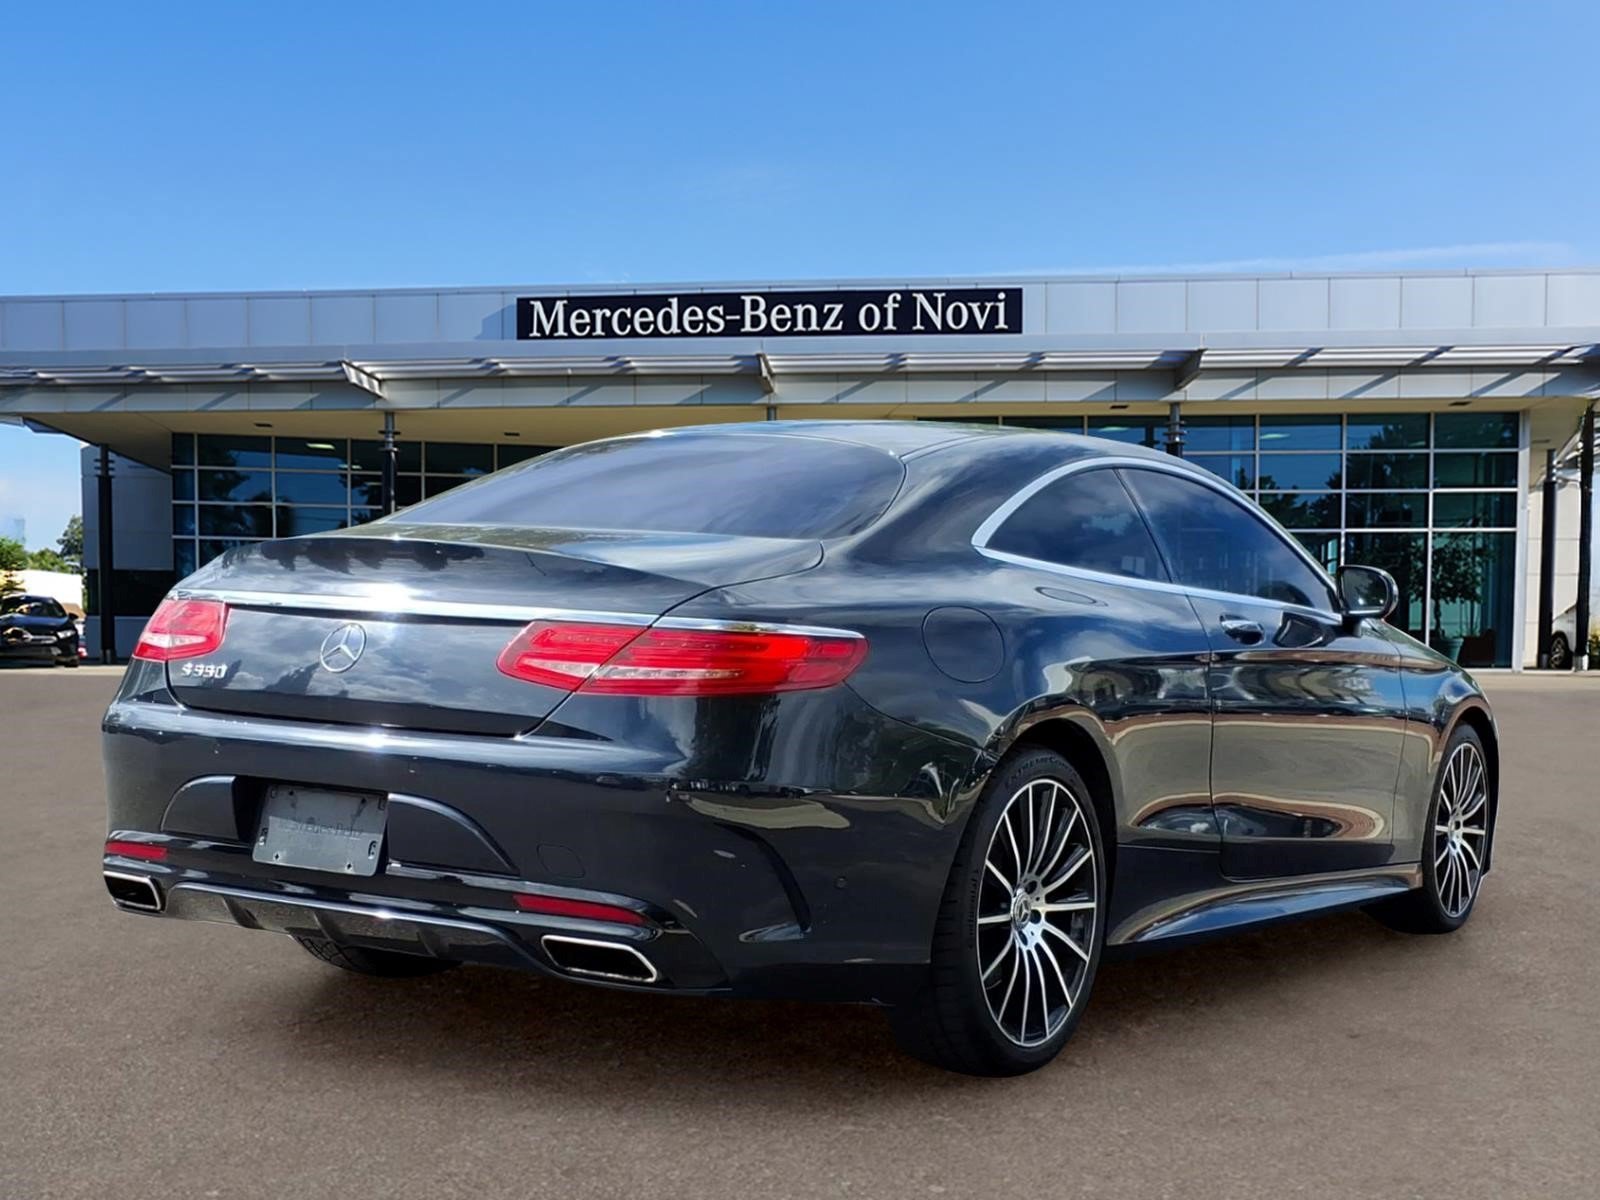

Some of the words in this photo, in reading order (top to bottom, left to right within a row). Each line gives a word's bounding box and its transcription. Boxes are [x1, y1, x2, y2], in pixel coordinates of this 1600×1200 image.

[529, 295, 844, 337] Mercedes-Benz
[858, 292, 902, 332] of
[912, 291, 1009, 331] Novi
